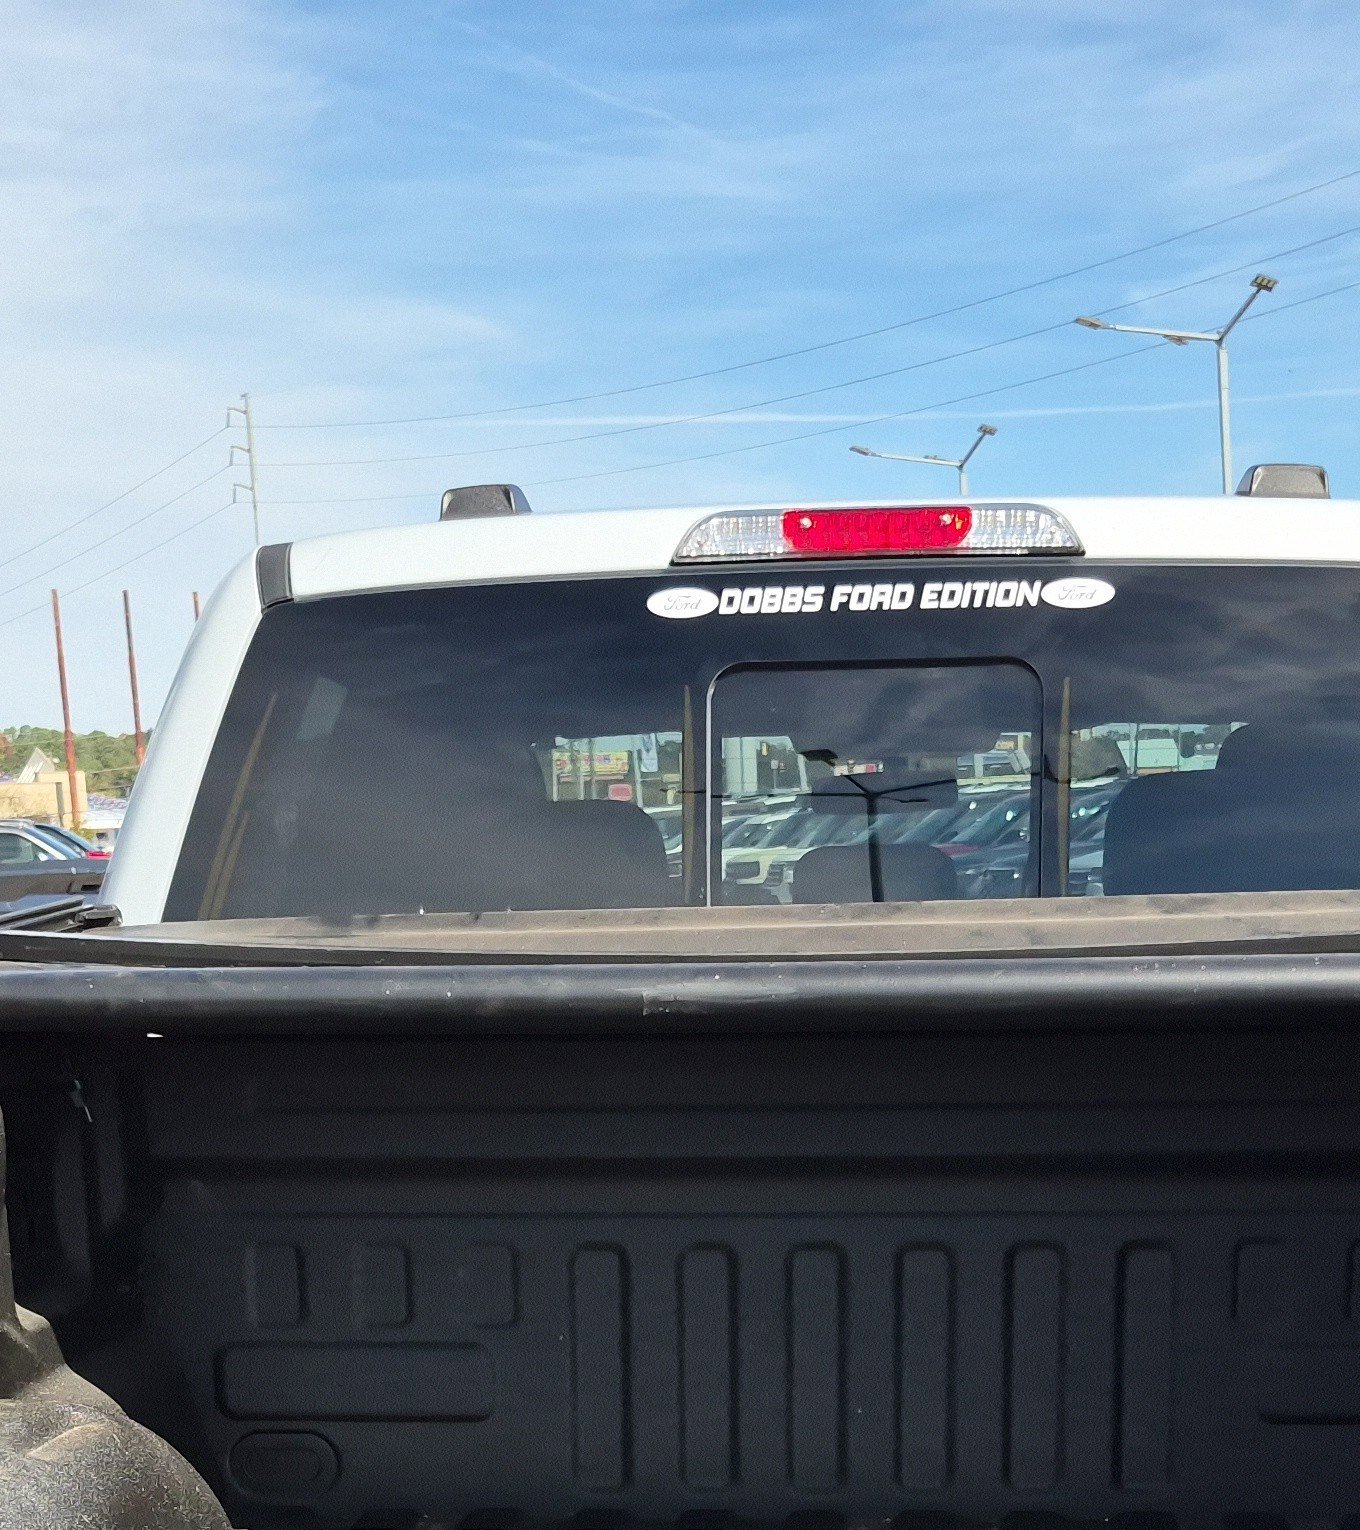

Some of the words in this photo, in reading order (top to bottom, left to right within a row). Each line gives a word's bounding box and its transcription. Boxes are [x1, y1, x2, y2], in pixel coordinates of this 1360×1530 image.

[663, 595, 702, 611] Ford
[719, 586, 825, 615] DOBBS
[830, 583, 915, 612] FORD
[919, 579, 1041, 610] EDITION
[1058, 584, 1097, 601] Ford
